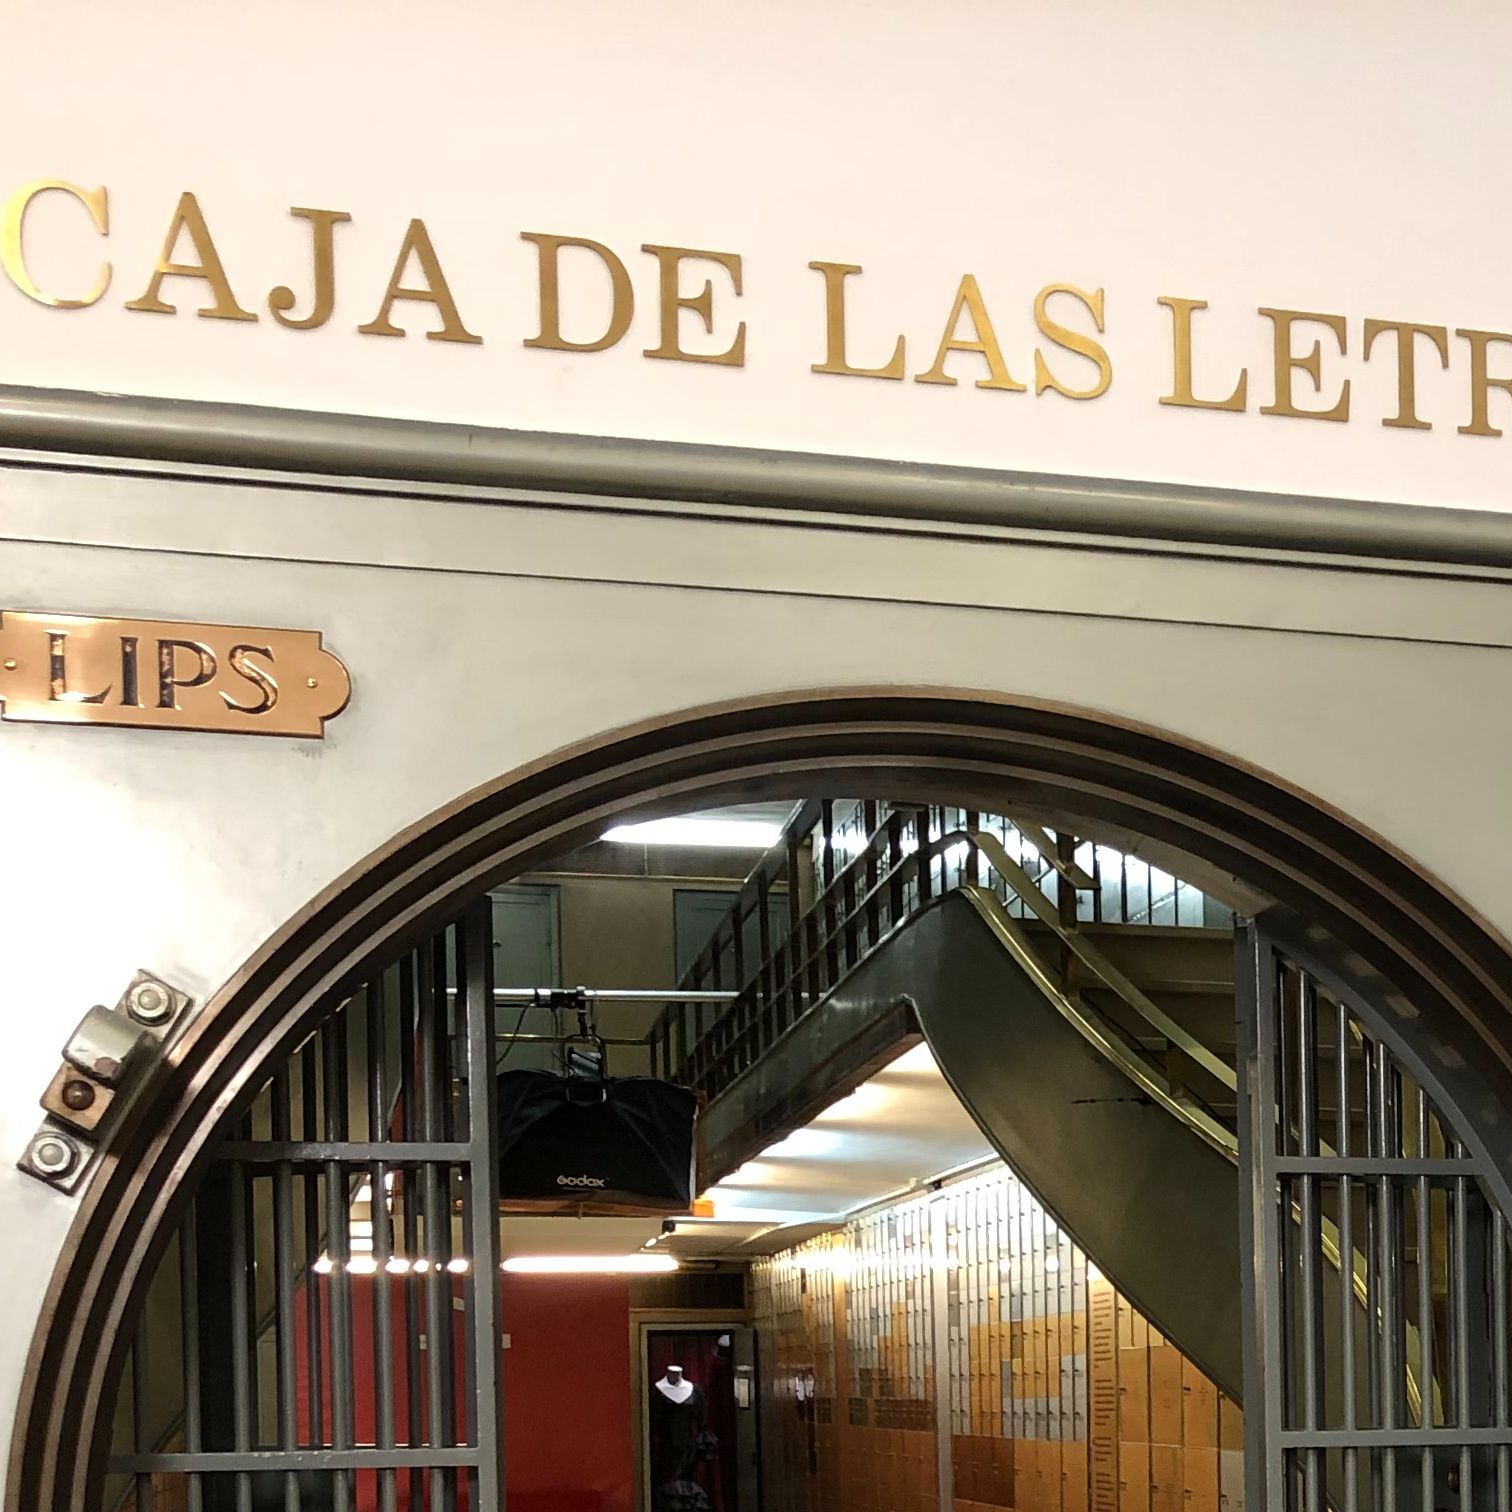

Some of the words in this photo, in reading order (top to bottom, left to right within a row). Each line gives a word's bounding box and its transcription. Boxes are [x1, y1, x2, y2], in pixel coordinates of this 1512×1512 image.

[0, 178, 484, 346] CAJA
[520, 231, 747, 367] DE
[808, 260, 1114, 401] LAS
[43, 629, 279, 714] LIPS
